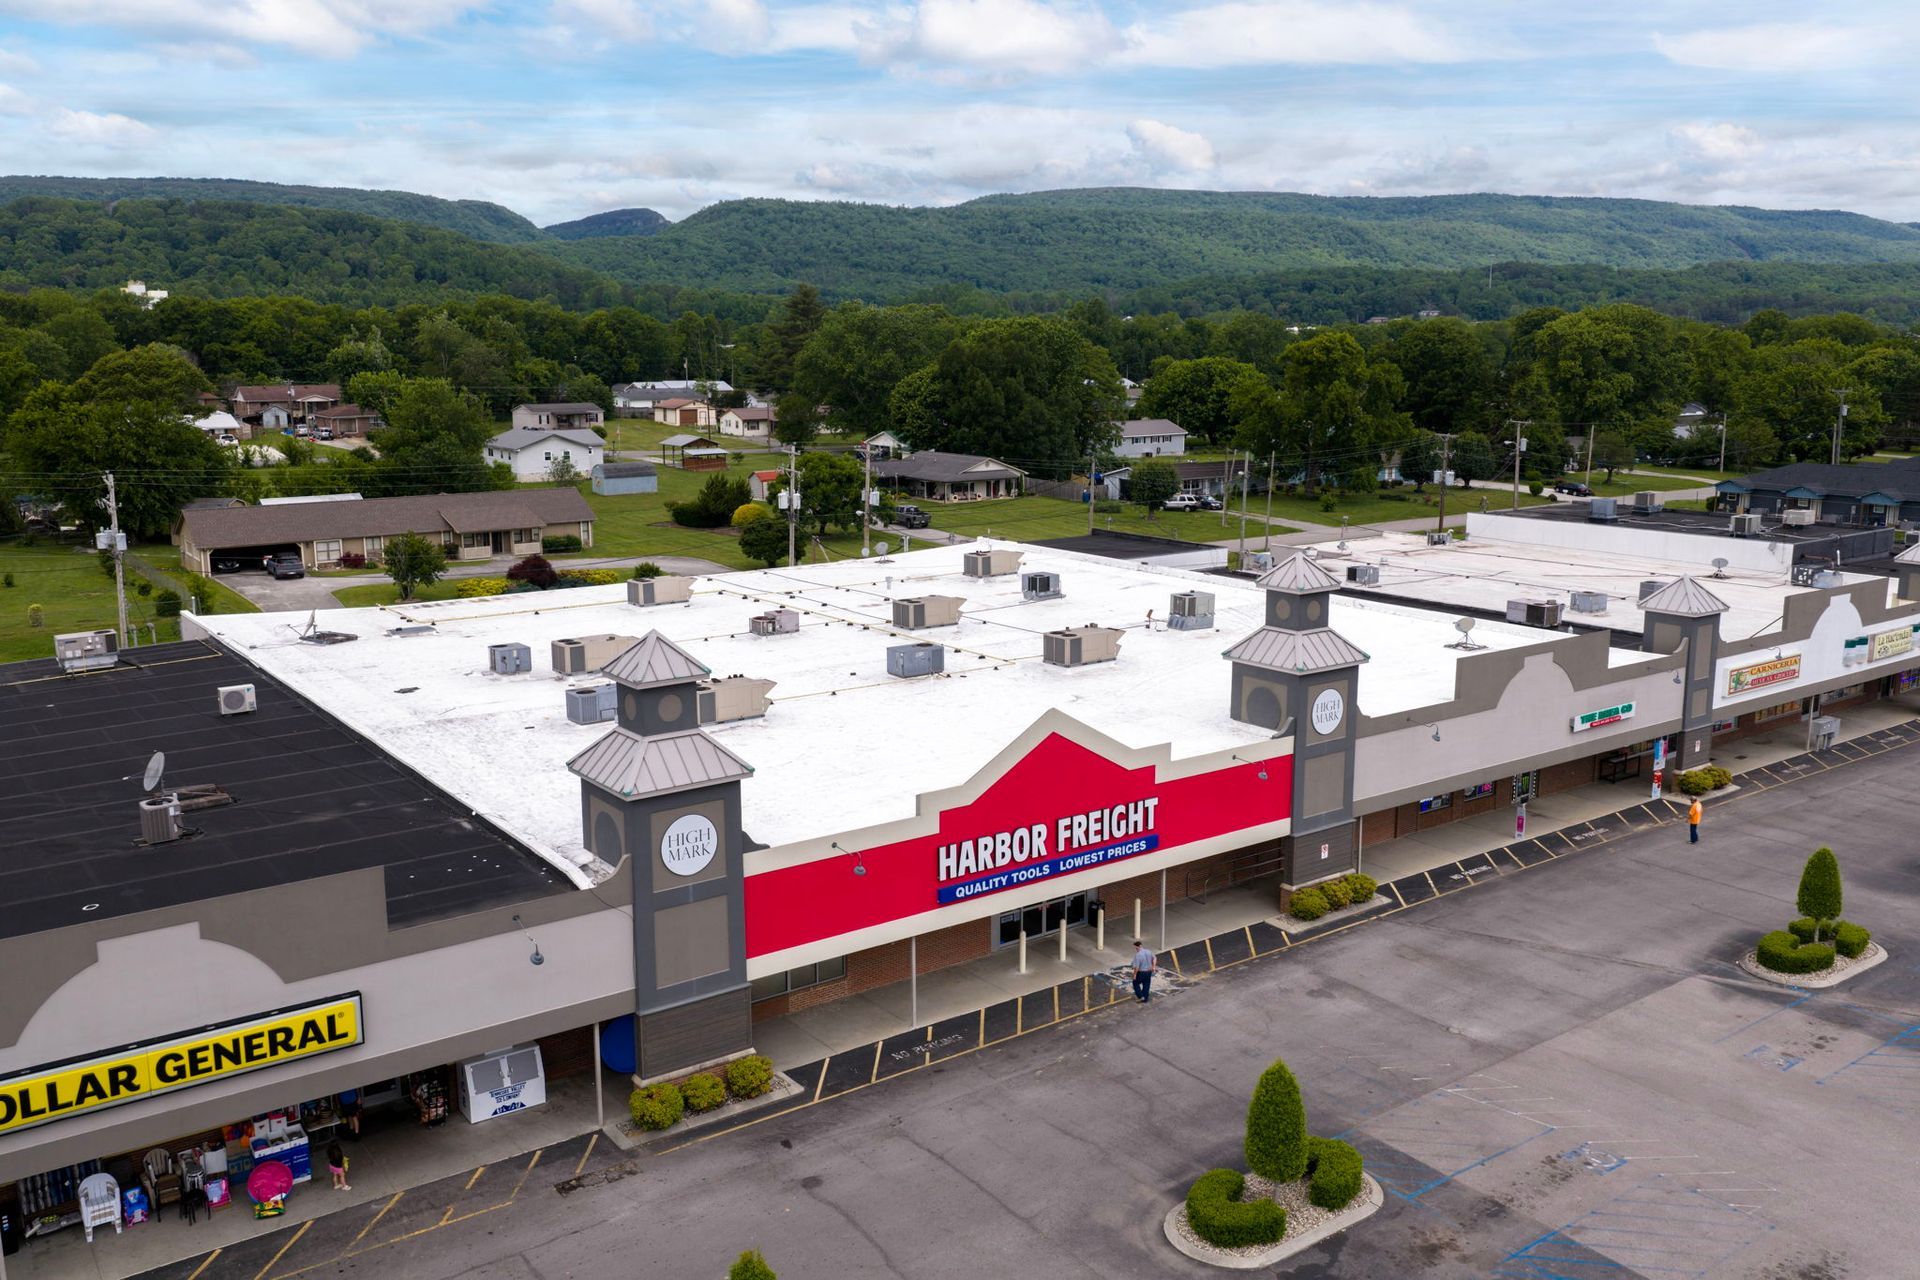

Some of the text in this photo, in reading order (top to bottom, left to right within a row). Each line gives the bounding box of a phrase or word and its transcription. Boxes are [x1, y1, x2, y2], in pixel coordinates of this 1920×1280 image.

[1750, 658, 1798, 675] CARNICERIA
[1316, 699, 1340, 713] HIGH
[1316, 711, 1339, 724] MARK
[668, 827, 710, 848] HIGH
[938, 797, 1159, 881] HARBOR FREIGHT
[668, 843, 711, 863] MARK
[955, 840, 1147, 898] QUALITY TOOLS LOWEST PRICES
[155, 1014, 349, 1084] GENERAL
[891, 1034, 963, 1060] NO PARKING
